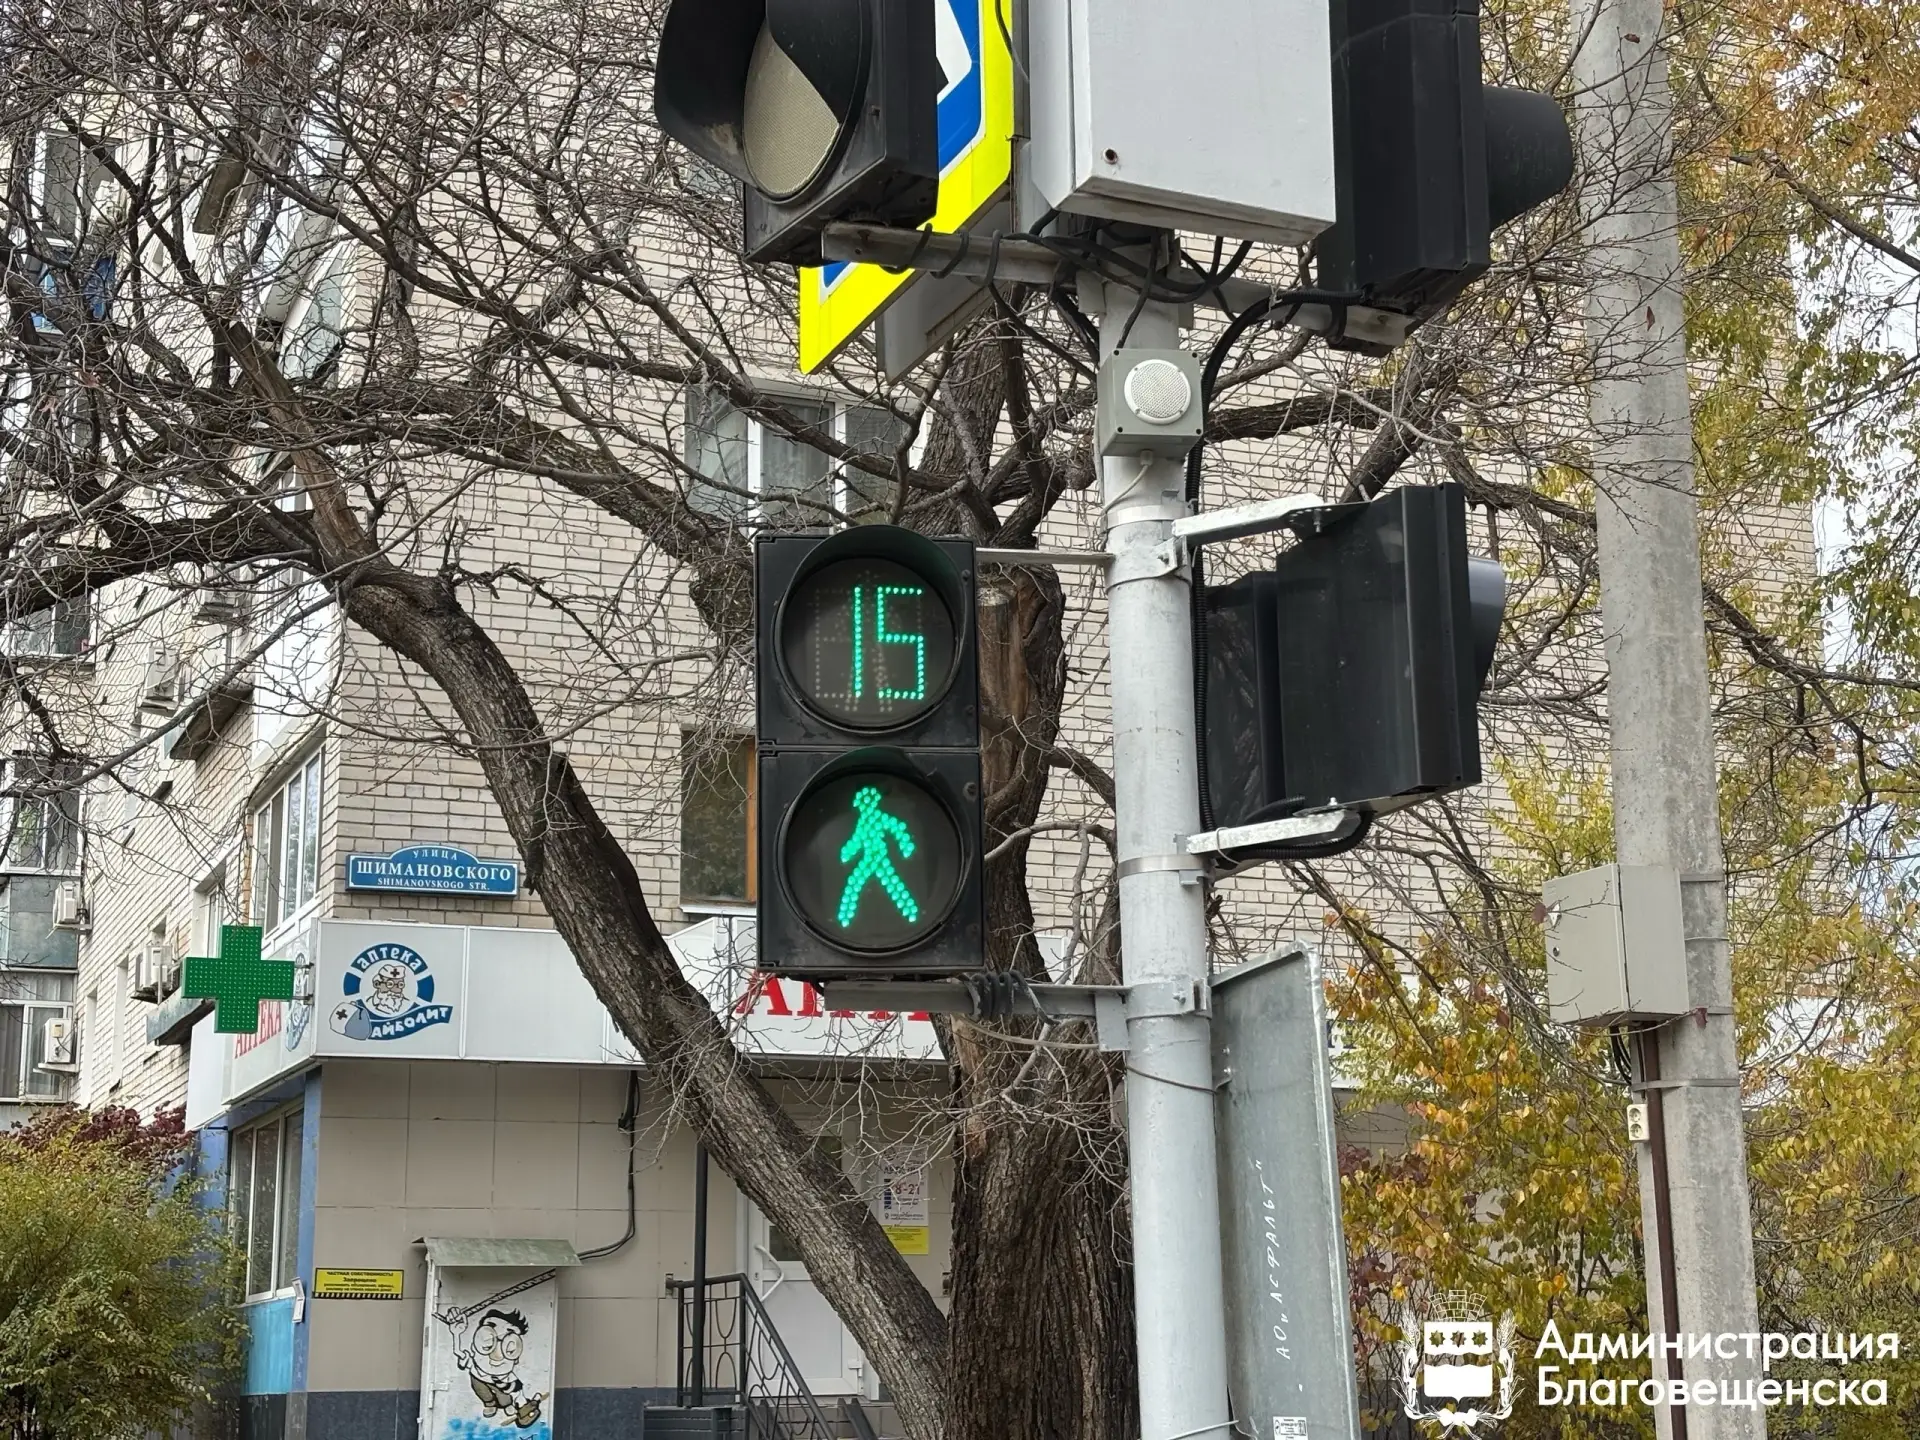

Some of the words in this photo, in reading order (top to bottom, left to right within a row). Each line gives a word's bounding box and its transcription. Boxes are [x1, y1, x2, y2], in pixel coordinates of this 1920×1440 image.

[854, 586, 926, 700] 15
[413, 850, 458, 861] УЛИЦА
[356, 860, 512, 882] ШИМАНОВСКОГО
[377, 877, 464, 890] SHIMANOVSKOGO
[469, 882, 491, 891] STR.
[356, 947, 422, 977] аптека
[371, 1006, 450, 1038] АЙБОЛИТ
